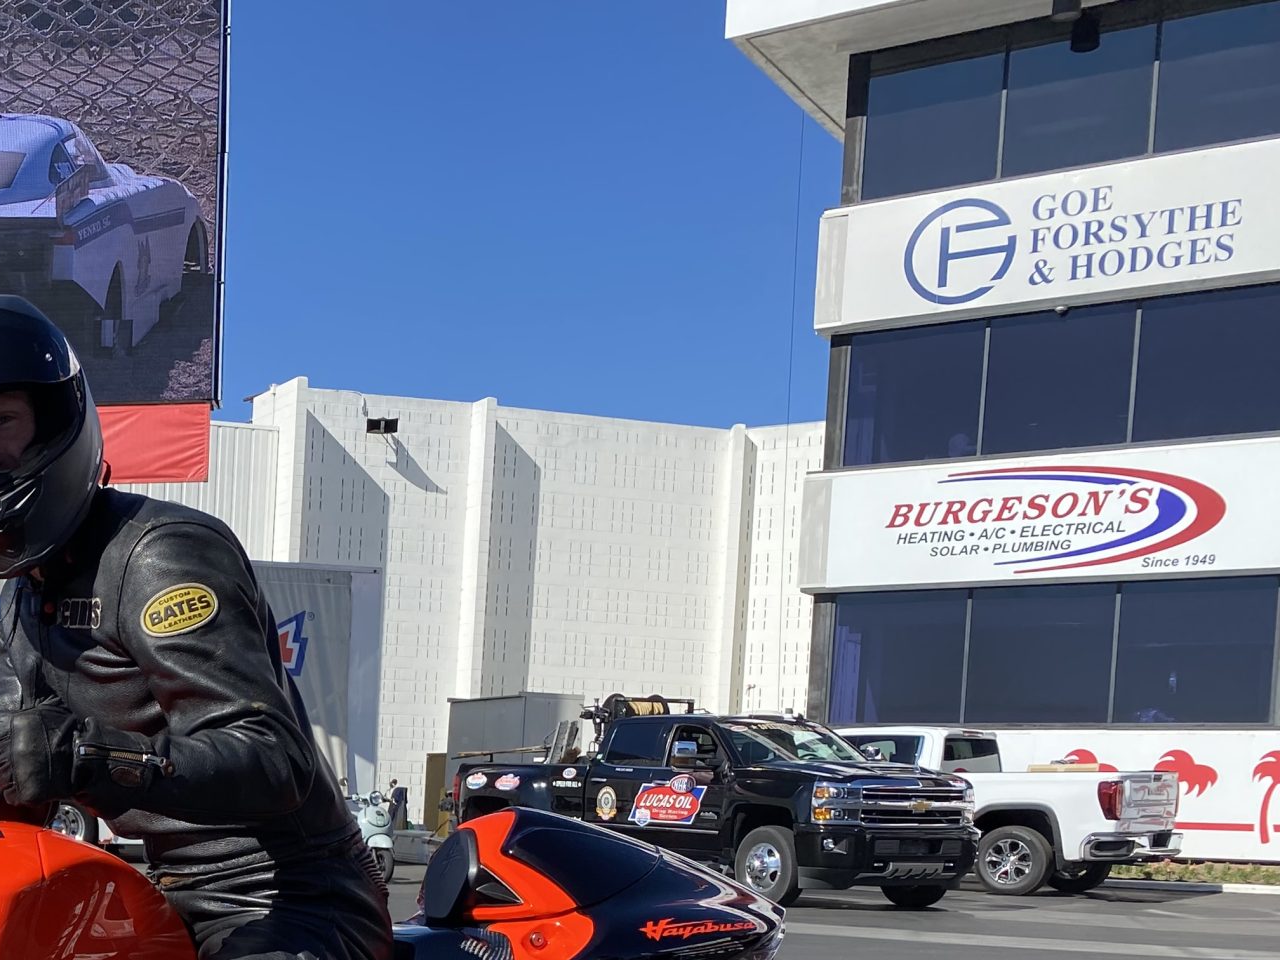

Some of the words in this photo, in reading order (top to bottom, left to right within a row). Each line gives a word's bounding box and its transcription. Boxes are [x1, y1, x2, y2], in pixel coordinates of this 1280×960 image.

[1032, 185, 1113, 221] GOE
[1029, 198, 1243, 254] FORSYTHE
[1028, 258, 1056, 286] &
[1068, 233, 1235, 281] HODGES
[885, 487, 1154, 528] BURGESON'S
[897, 529, 966, 544] HEATING
[978, 527, 1007, 541] A/C
[1020, 520, 1126, 538] ELECTRICAL
[929, 544, 980, 557] SOLAR
[992, 539, 1072, 554] PLUMBING
[1141, 556, 1179, 568] Since
[1184, 554, 1216, 566] 1949
[158, 590, 191, 605] CUSTOM
[148, 594, 212, 627] BATES
[163, 612, 204, 630] LEATHERS
[640, 793, 675, 808] LUCAS
[675, 795, 693, 809] OIL
[640, 918, 758, 942] Hayabusa
